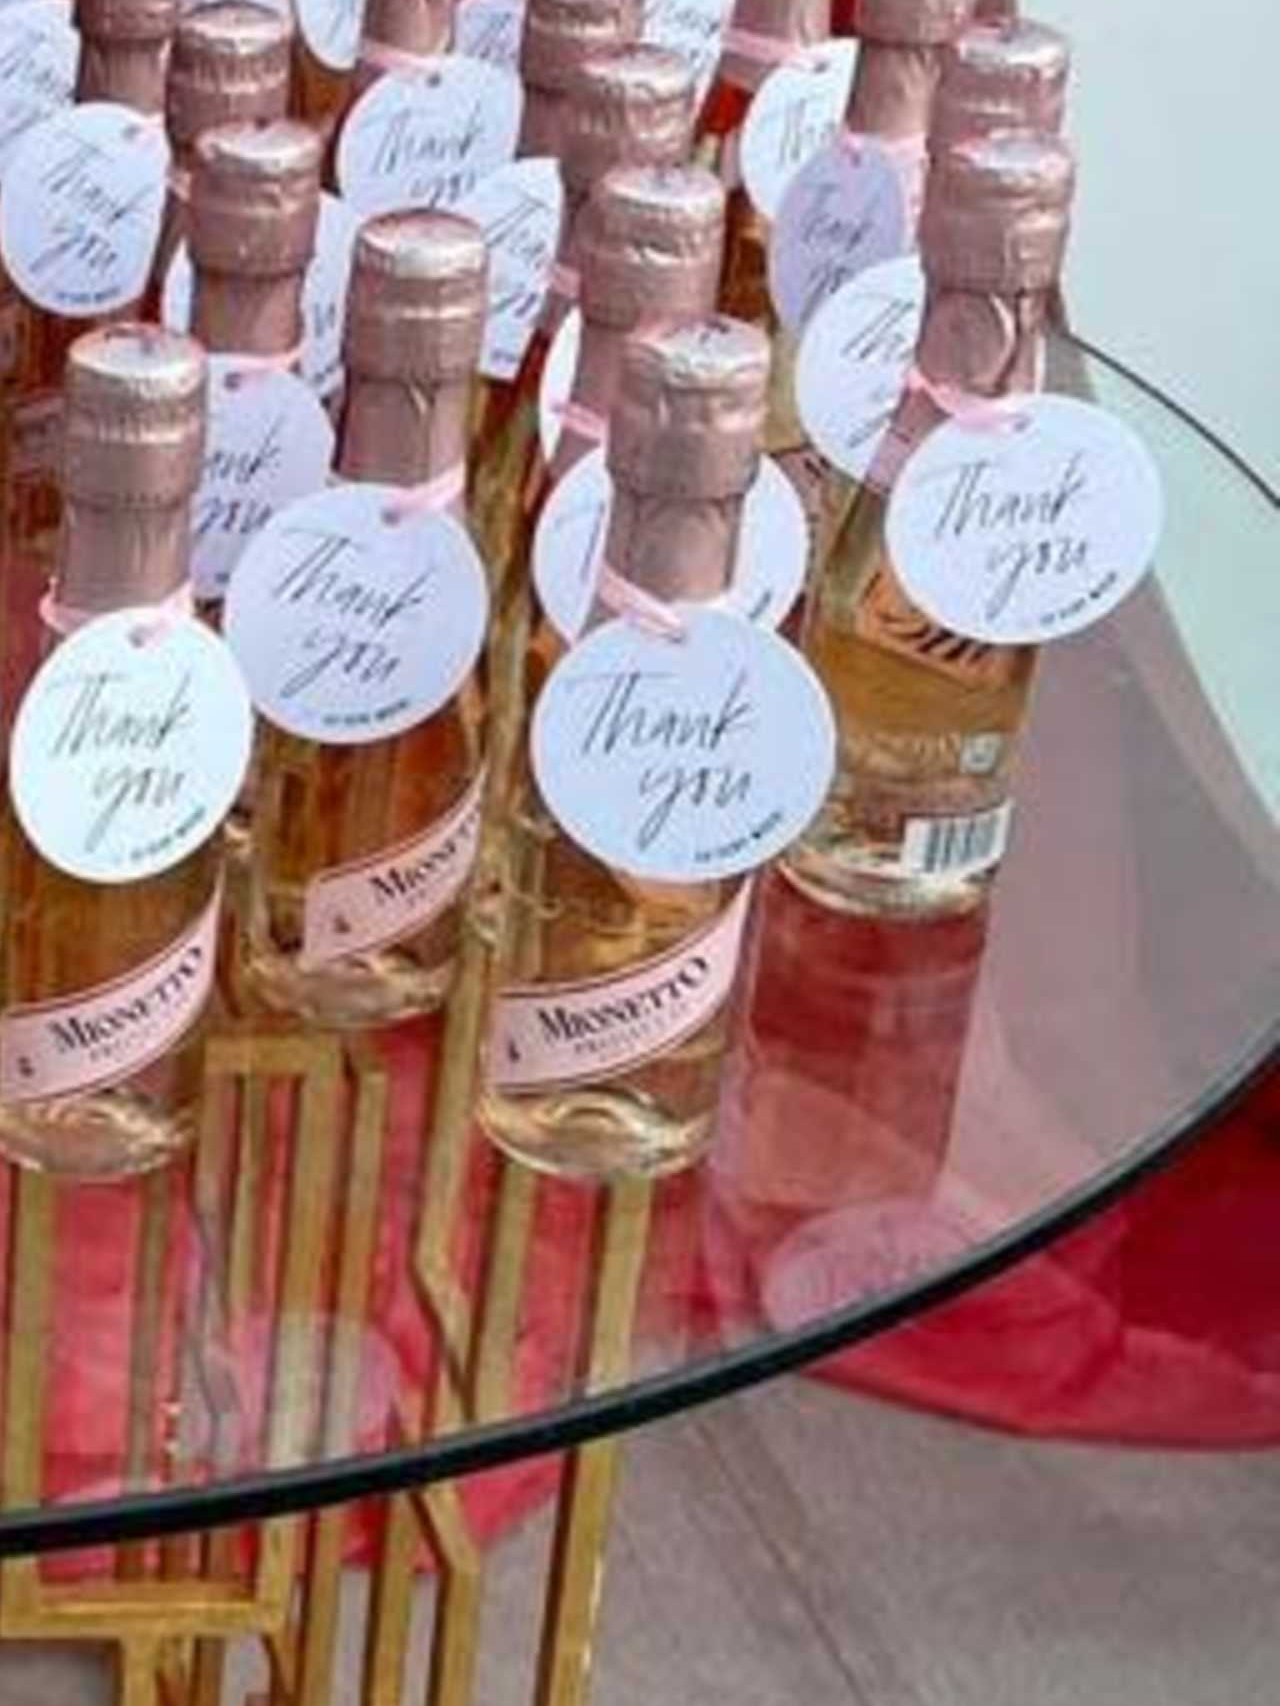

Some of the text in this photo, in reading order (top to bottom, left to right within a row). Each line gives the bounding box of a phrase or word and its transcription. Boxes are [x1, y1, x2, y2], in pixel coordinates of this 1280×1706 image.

[918, 446, 1085, 542] Thank
[271, 526, 437, 628] Thank
[986, 539, 1089, 621] you
[278, 625, 401, 700] you
[39, 671, 190, 757] Thank
[562, 662, 755, 756] Thank
[84, 762, 183, 854] you
[635, 764, 752, 852] you
[48, 945, 204, 1054] MIONETTO
[538, 956, 712, 1044] MIONETTO
